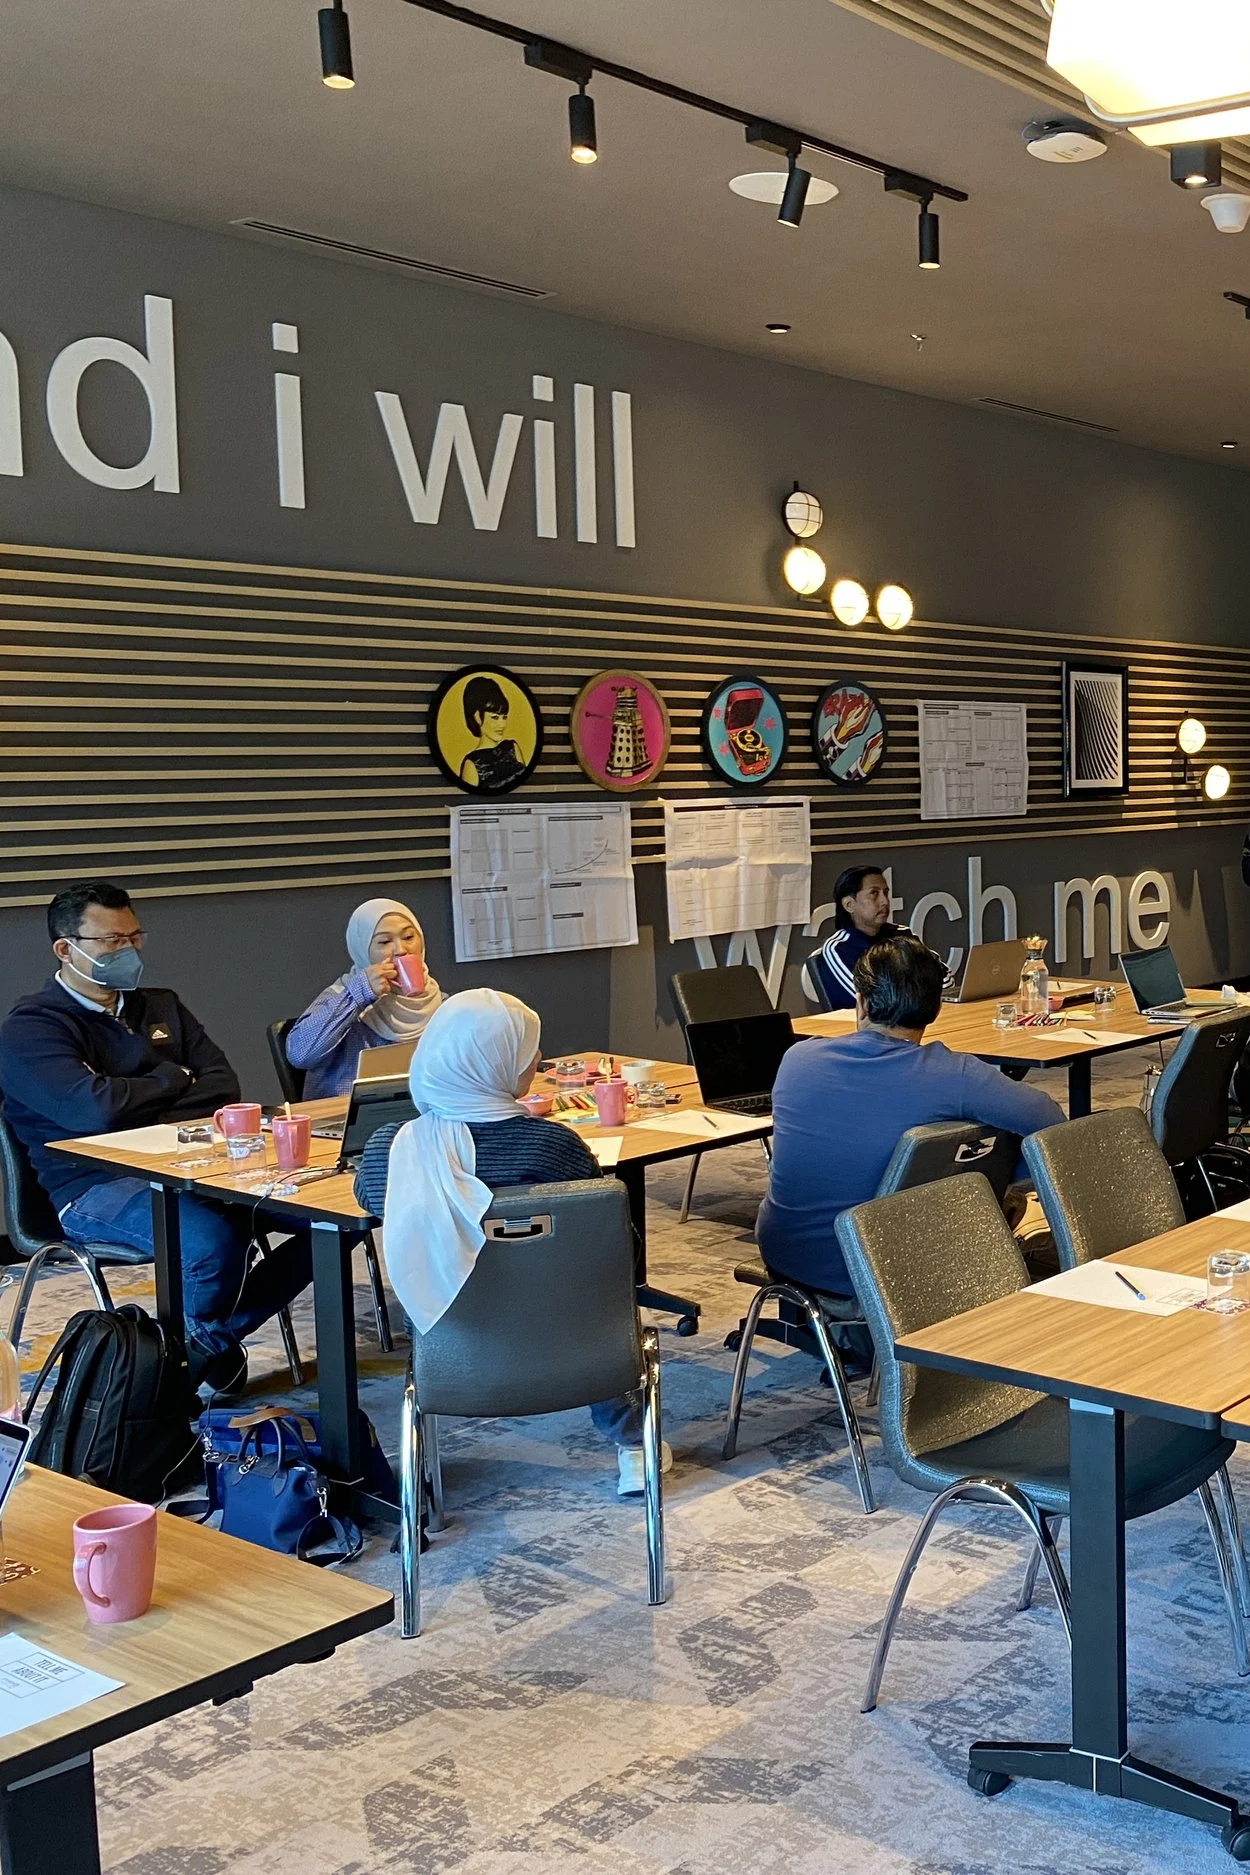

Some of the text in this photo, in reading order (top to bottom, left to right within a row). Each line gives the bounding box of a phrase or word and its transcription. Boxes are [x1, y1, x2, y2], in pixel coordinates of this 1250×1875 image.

[272, 322, 306, 509] i
[374, 374, 636, 548] will
[1054, 870, 1171, 964] me
